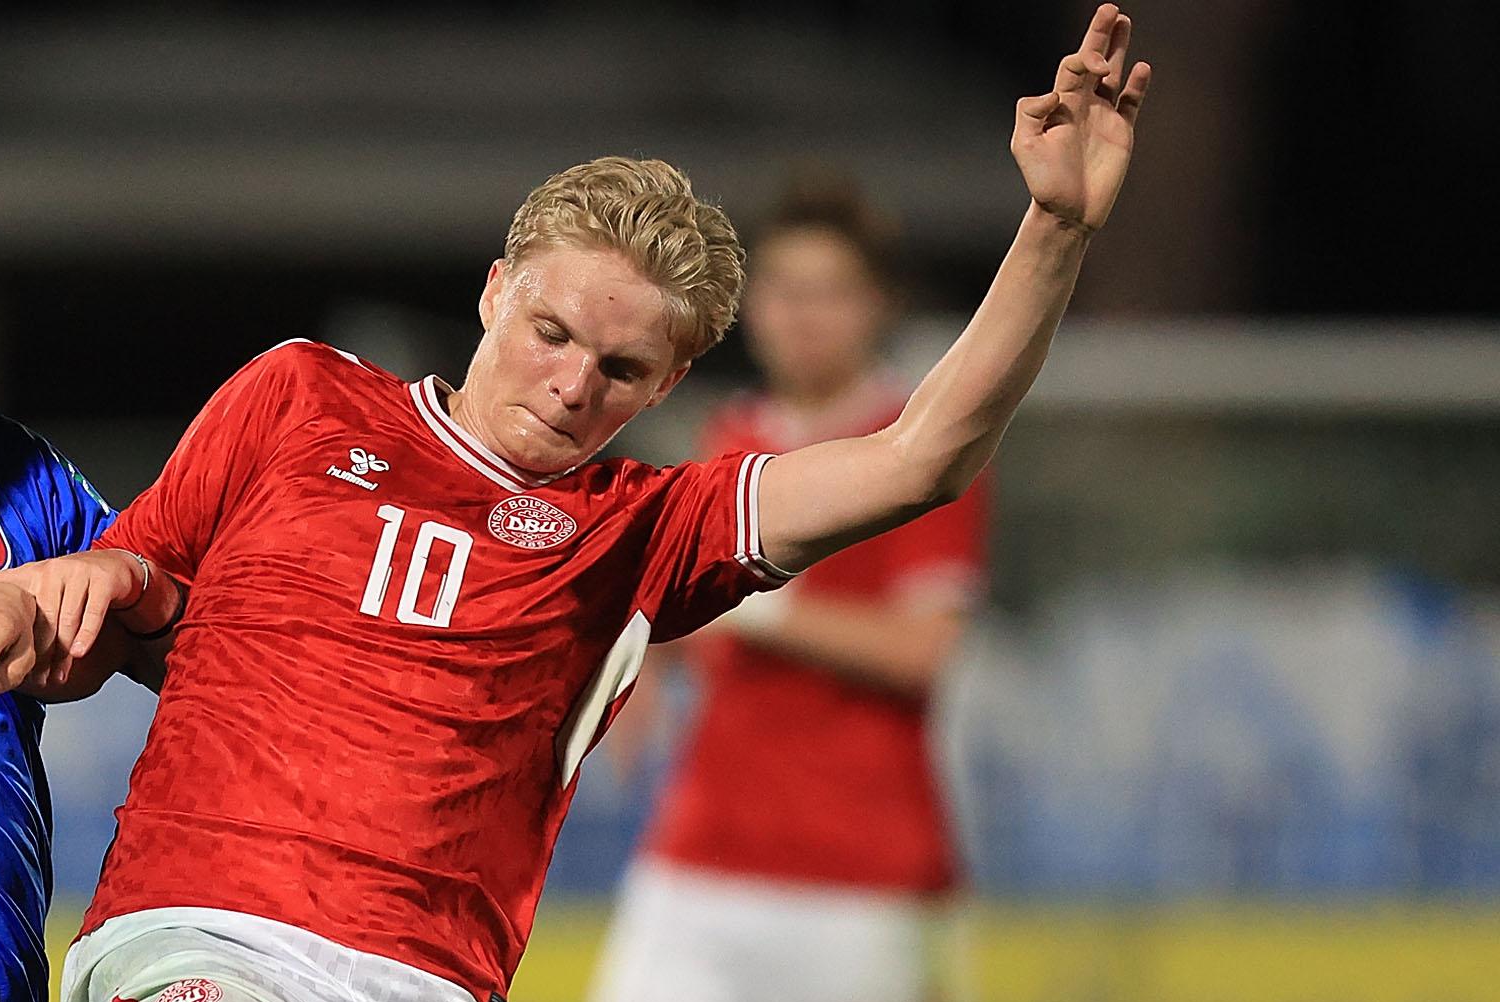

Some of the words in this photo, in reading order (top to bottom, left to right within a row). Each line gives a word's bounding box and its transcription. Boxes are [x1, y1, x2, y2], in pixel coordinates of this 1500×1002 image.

[326, 465, 379, 491] hummel
[505, 515, 559, 533] DBU
[359, 504, 475, 629] 10
